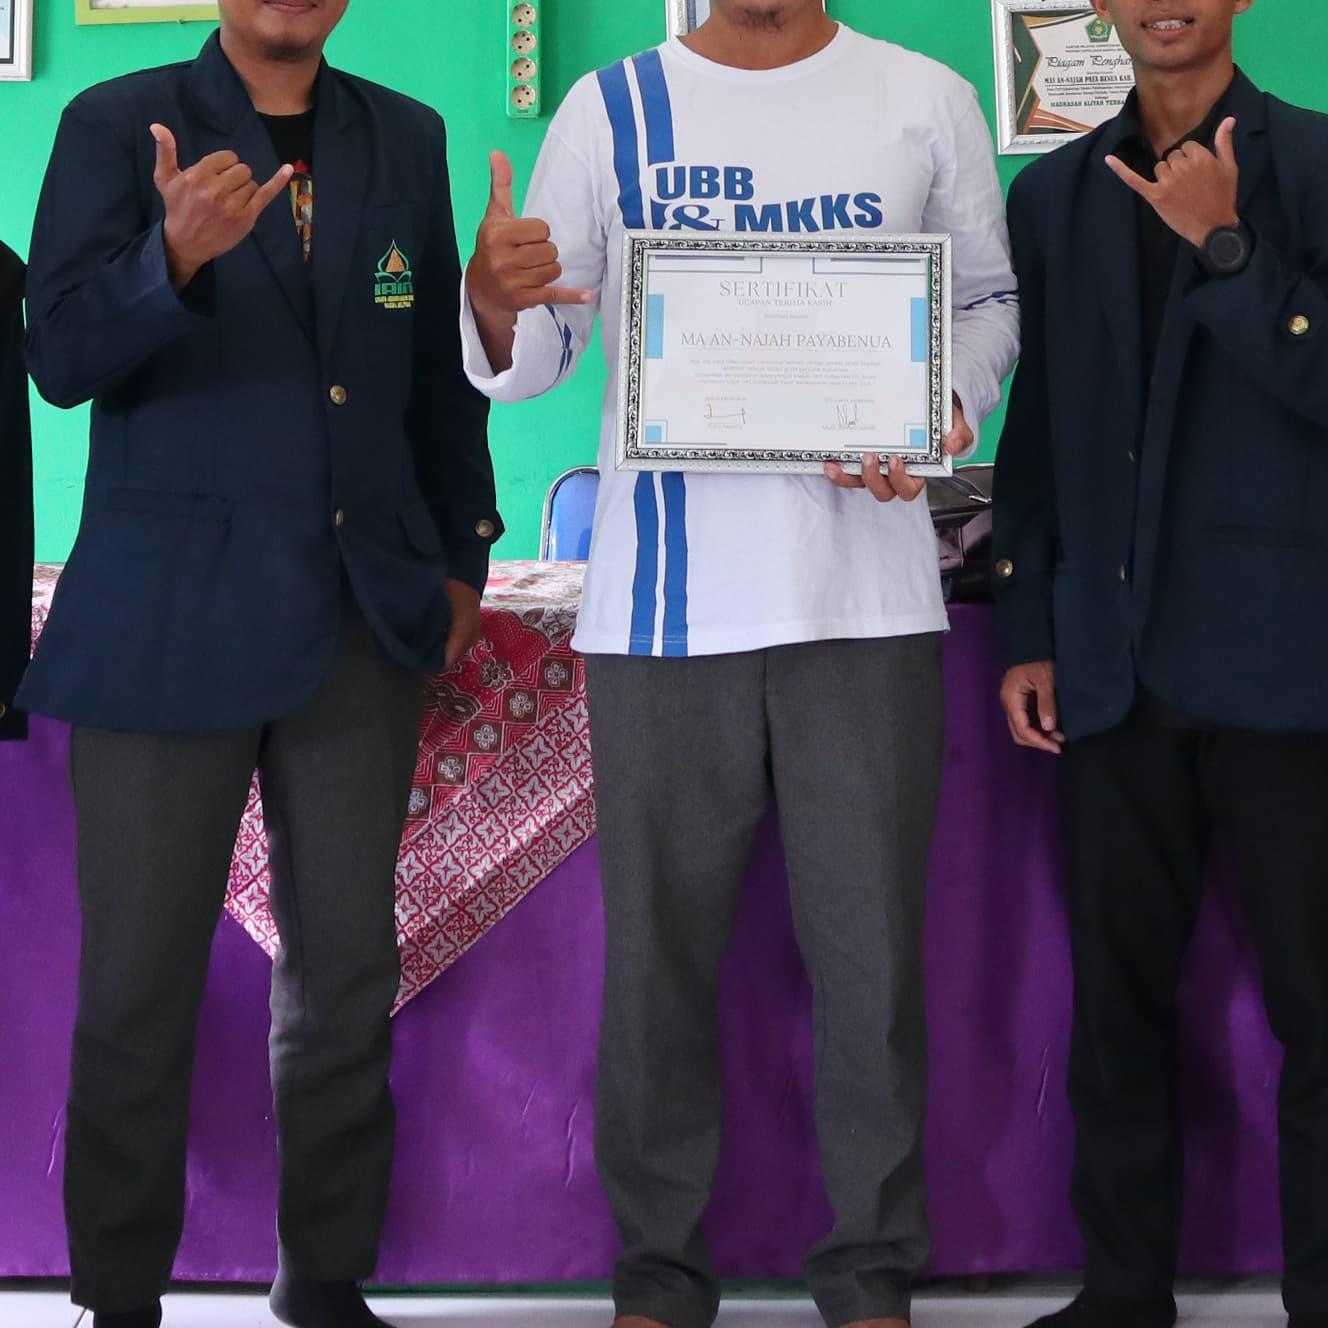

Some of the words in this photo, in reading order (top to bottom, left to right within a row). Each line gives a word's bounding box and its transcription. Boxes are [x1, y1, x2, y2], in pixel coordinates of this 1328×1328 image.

[1045, 56, 1085, 71] Piagam
[1090, 55, 1133, 70] Penghar
[655, 165, 754, 201] UBB
[671, 205, 725, 231] &
[734, 192, 883, 232] MKKS
[719, 281, 847, 298] SERTIFIKAT
[681, 333, 705, 346] MA
[710, 333, 791, 347] AN-NAJAH
[797, 334, 891, 348] PAYABENUA
